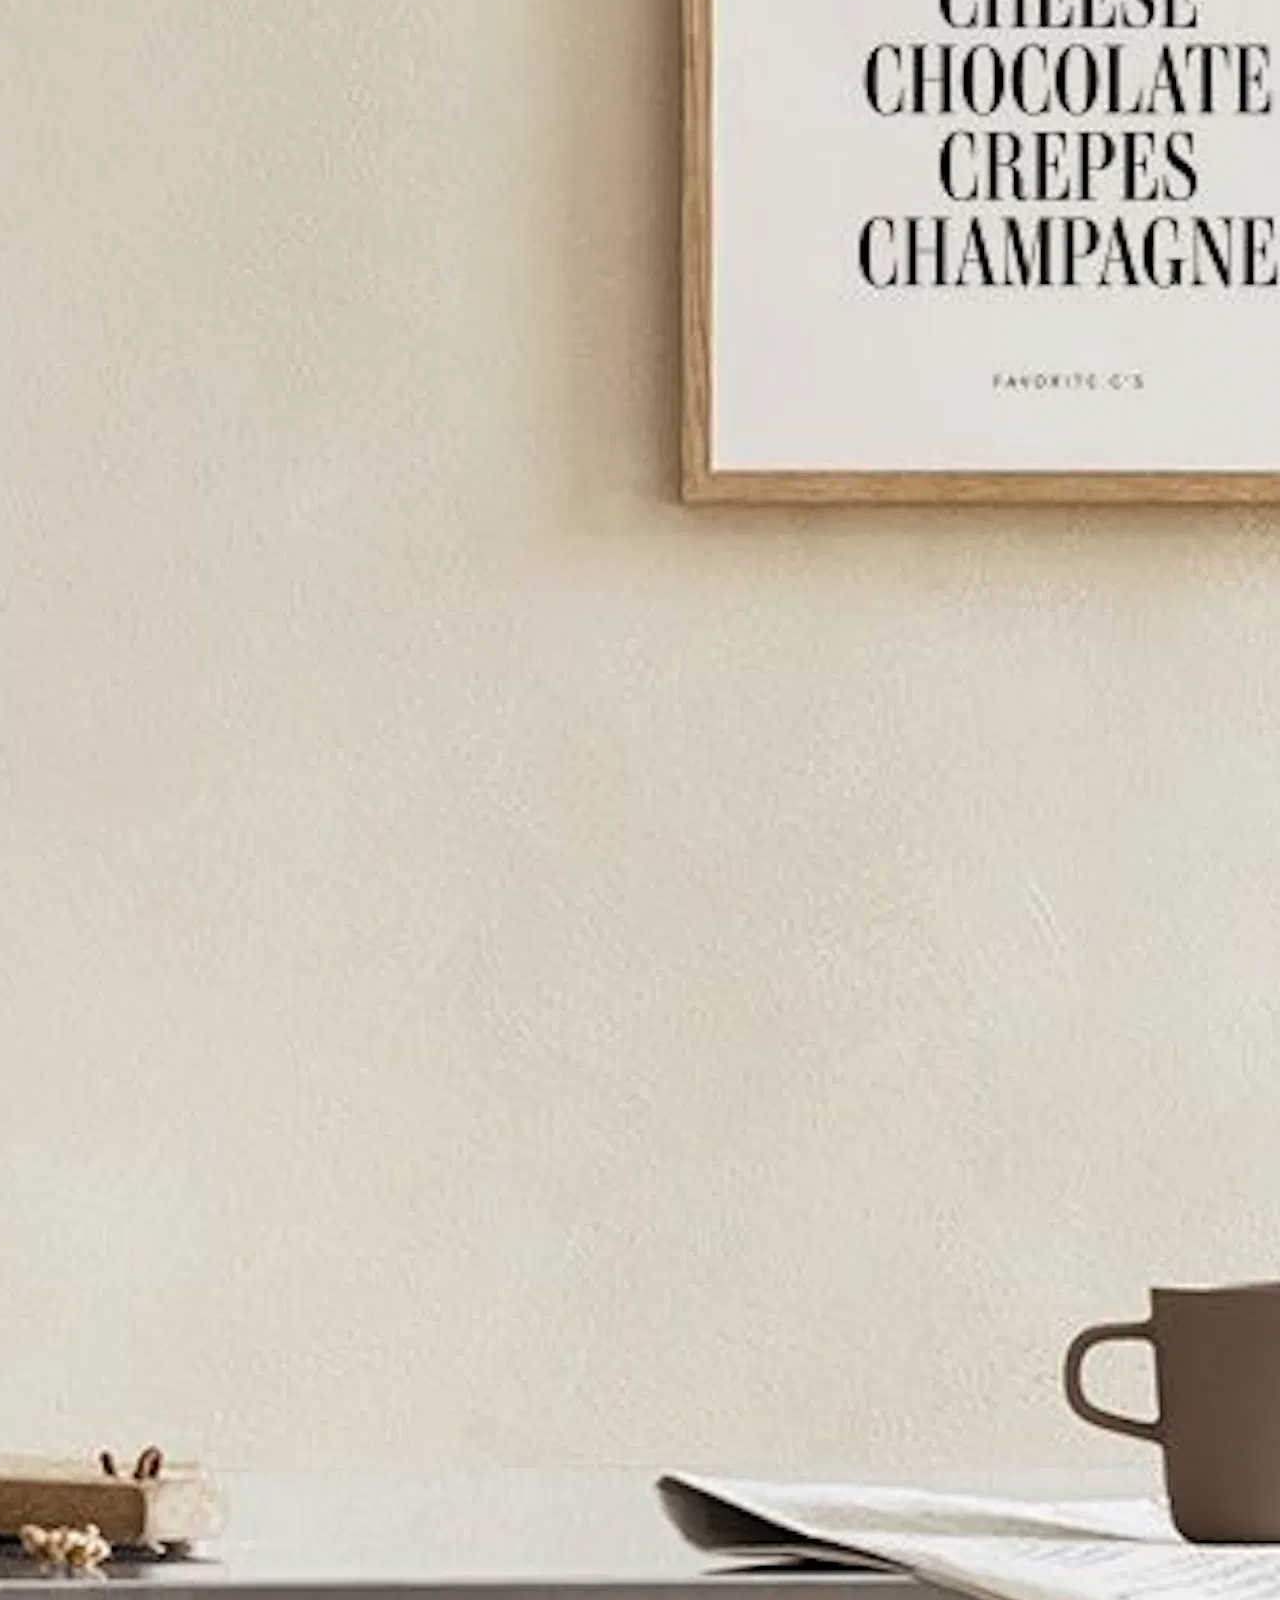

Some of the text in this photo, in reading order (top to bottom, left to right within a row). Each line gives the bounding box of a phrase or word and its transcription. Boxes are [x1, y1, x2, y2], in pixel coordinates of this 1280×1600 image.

[865, 44, 1271, 116] CHOCOLATE
[939, 131, 1198, 202] CREPES
[858, 217, 1278, 288] CHAMPAGNE
